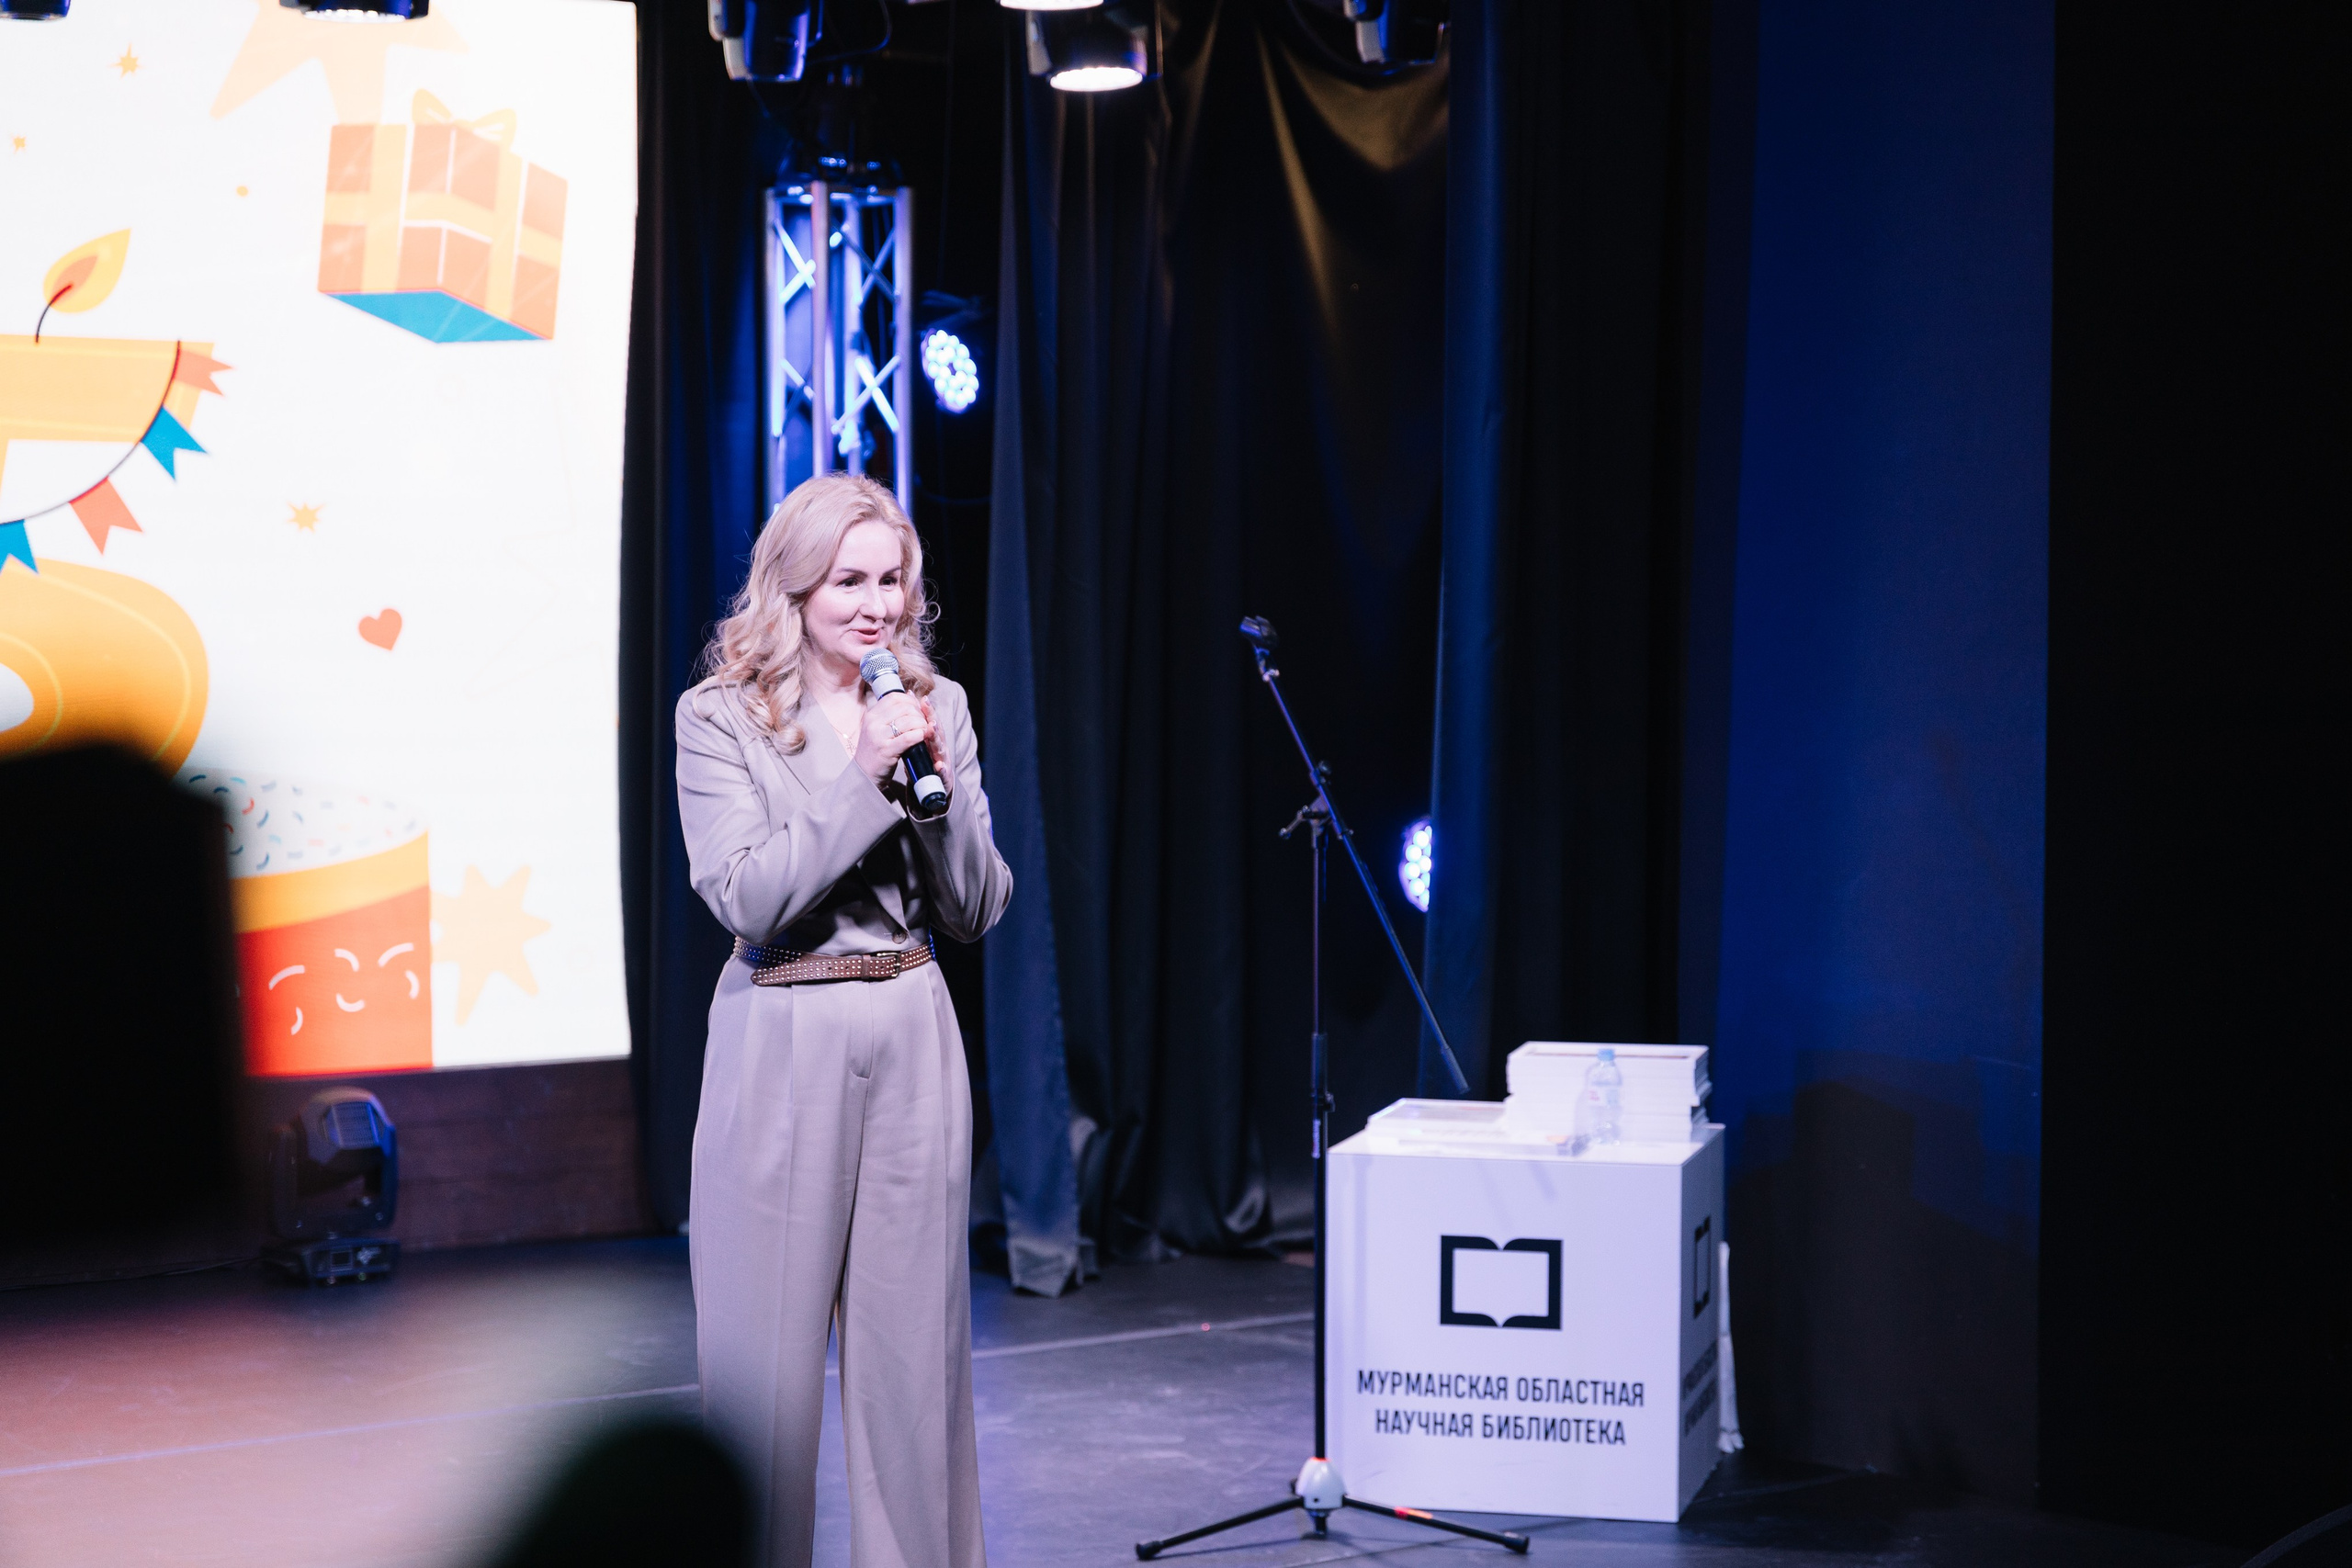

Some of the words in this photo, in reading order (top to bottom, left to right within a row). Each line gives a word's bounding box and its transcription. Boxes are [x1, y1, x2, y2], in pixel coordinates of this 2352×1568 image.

[1357, 1370, 1508, 1401] МУРМАНСКАЯ
[1517, 1377, 1644, 1407] ОБЛАСТНАЯ
[1375, 1409, 1473, 1438] НАУЧНАЯ
[1482, 1414, 1625, 1445] БИБЛИОТЕКА
